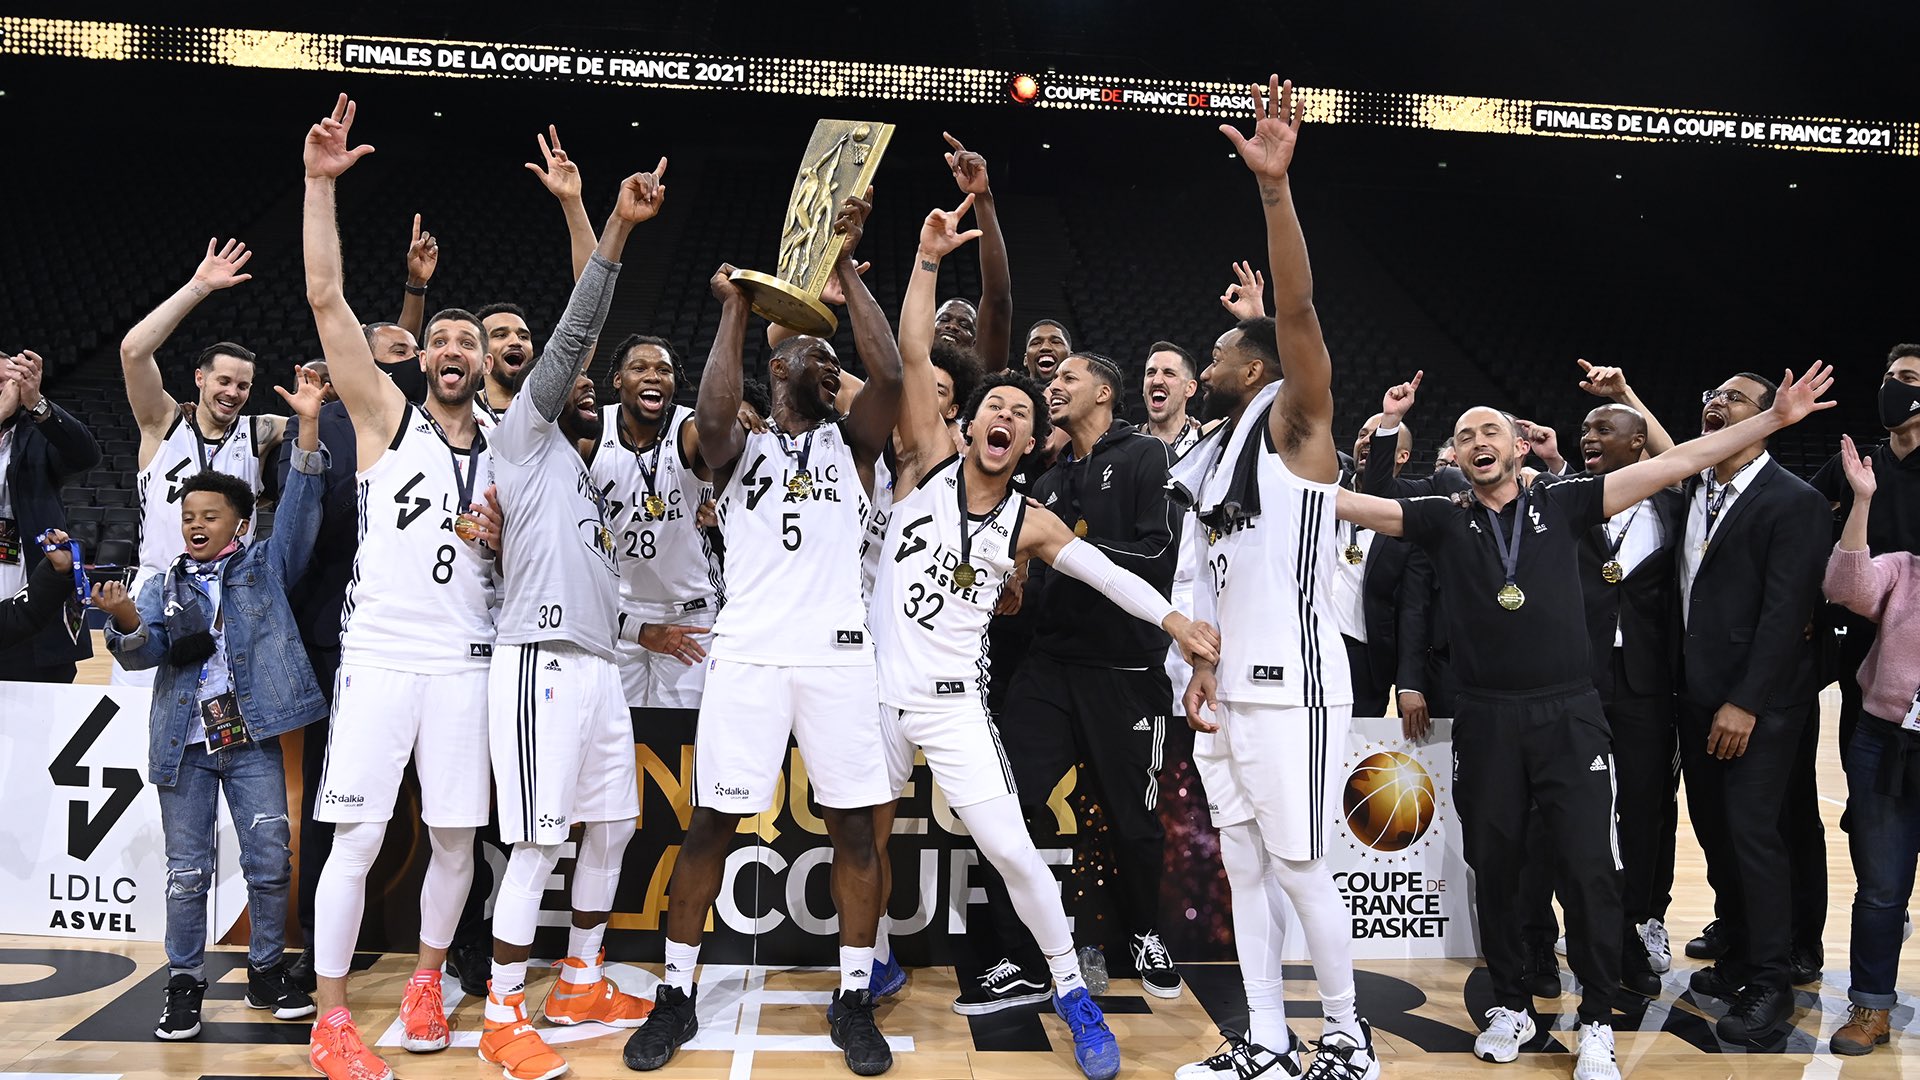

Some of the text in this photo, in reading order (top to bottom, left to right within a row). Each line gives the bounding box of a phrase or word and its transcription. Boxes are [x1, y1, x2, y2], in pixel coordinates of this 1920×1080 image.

[345, 44, 745, 82] FINALES DE LA COUPE DE FRANCE 2021
[1535, 109, 1891, 147] FINALES DE LA COUPE DE FRANCE 2021
[624, 530, 656, 559] 28
[782, 512, 802, 551] 5
[991, 521, 1009, 538] DCB
[432, 544, 457, 584] 8
[933, 543, 988, 586] LDC
[924, 564, 979, 604] ASVEL
[538, 604, 563, 629] 30
[904, 582, 944, 631] 32
[337, 795, 365, 803] dalkia
[724, 787, 750, 796] dalkia
[50, 873, 137, 904] LDLC
[1426, 880, 1447, 892] DE
[49, 909, 137, 933] ASVEL
[1351, 917, 1450, 938] BASKET
